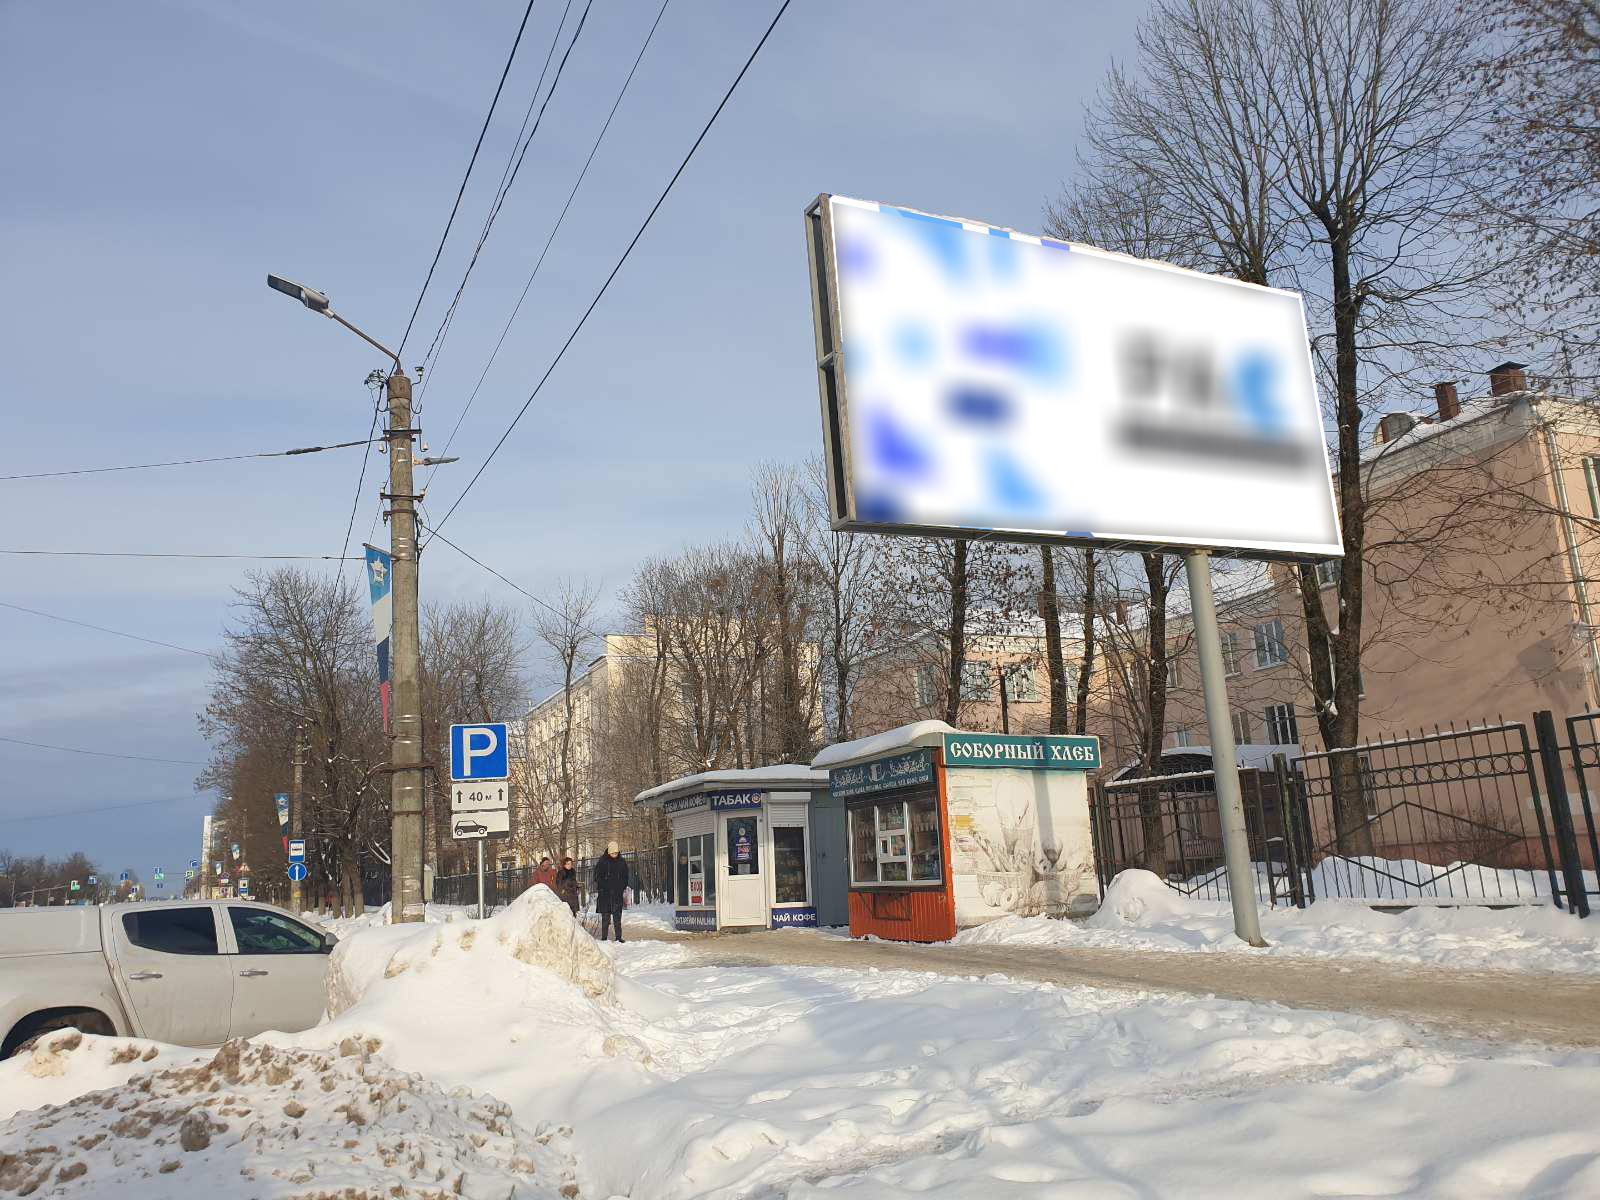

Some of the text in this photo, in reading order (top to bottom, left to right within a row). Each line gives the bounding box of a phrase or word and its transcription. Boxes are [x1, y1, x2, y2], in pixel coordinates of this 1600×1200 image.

[463, 727, 498, 776] P
[950, 742, 1094, 761] СОБОРНЫЙ ХЛЕБ
[469, 791, 483, 802] 40
[712, 795, 750, 806] ТАБАК
[773, 913, 816, 922] ЧАЙ КОФЕ
